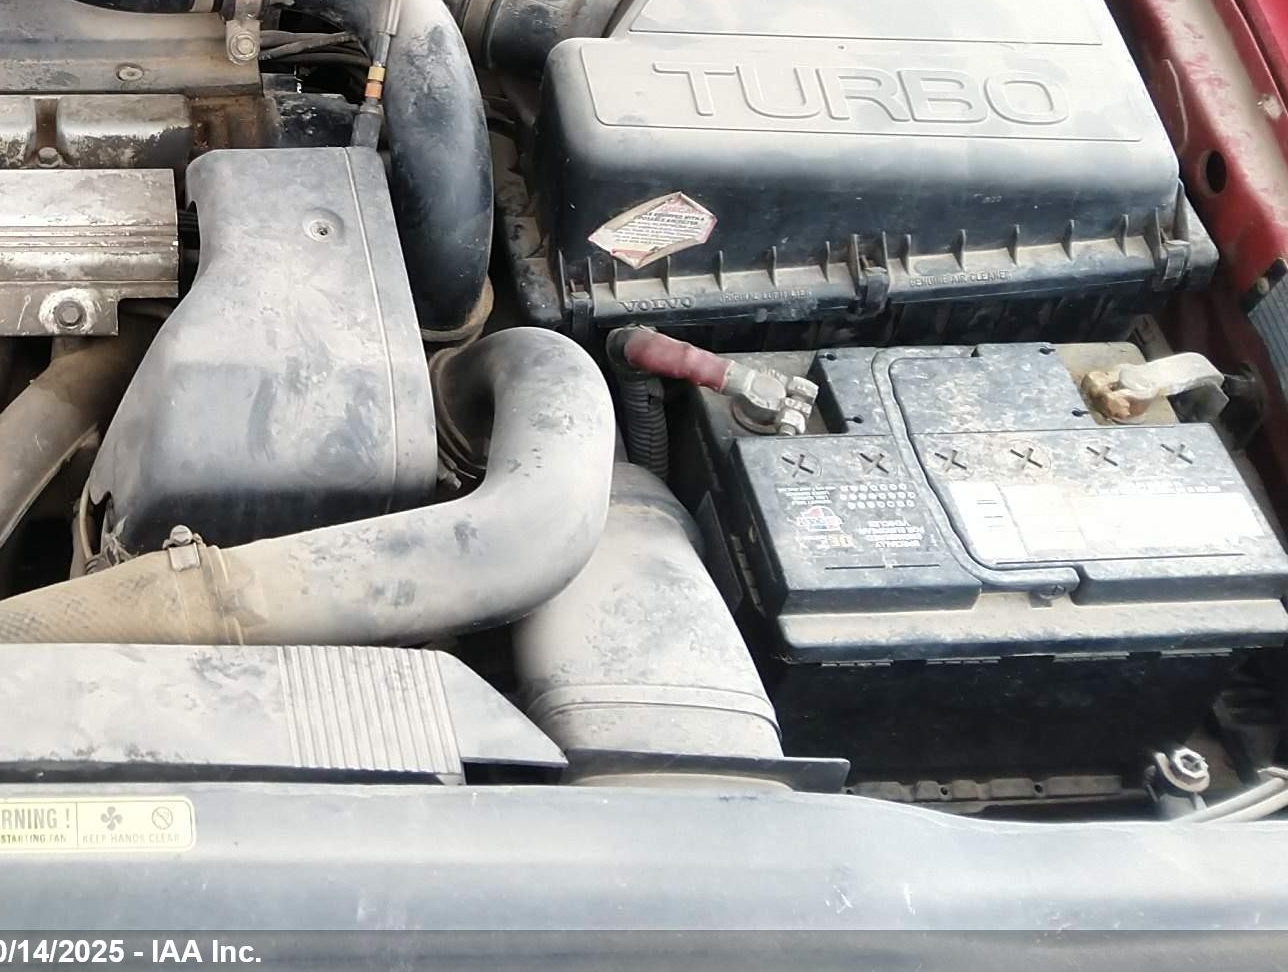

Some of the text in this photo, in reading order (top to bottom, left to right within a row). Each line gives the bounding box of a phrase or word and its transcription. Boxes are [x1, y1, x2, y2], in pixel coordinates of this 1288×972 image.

[652, 61, 1071, 125] TURBO
[951, 273, 967, 285] AIR
[620, 295, 697, 313] VOLVO
